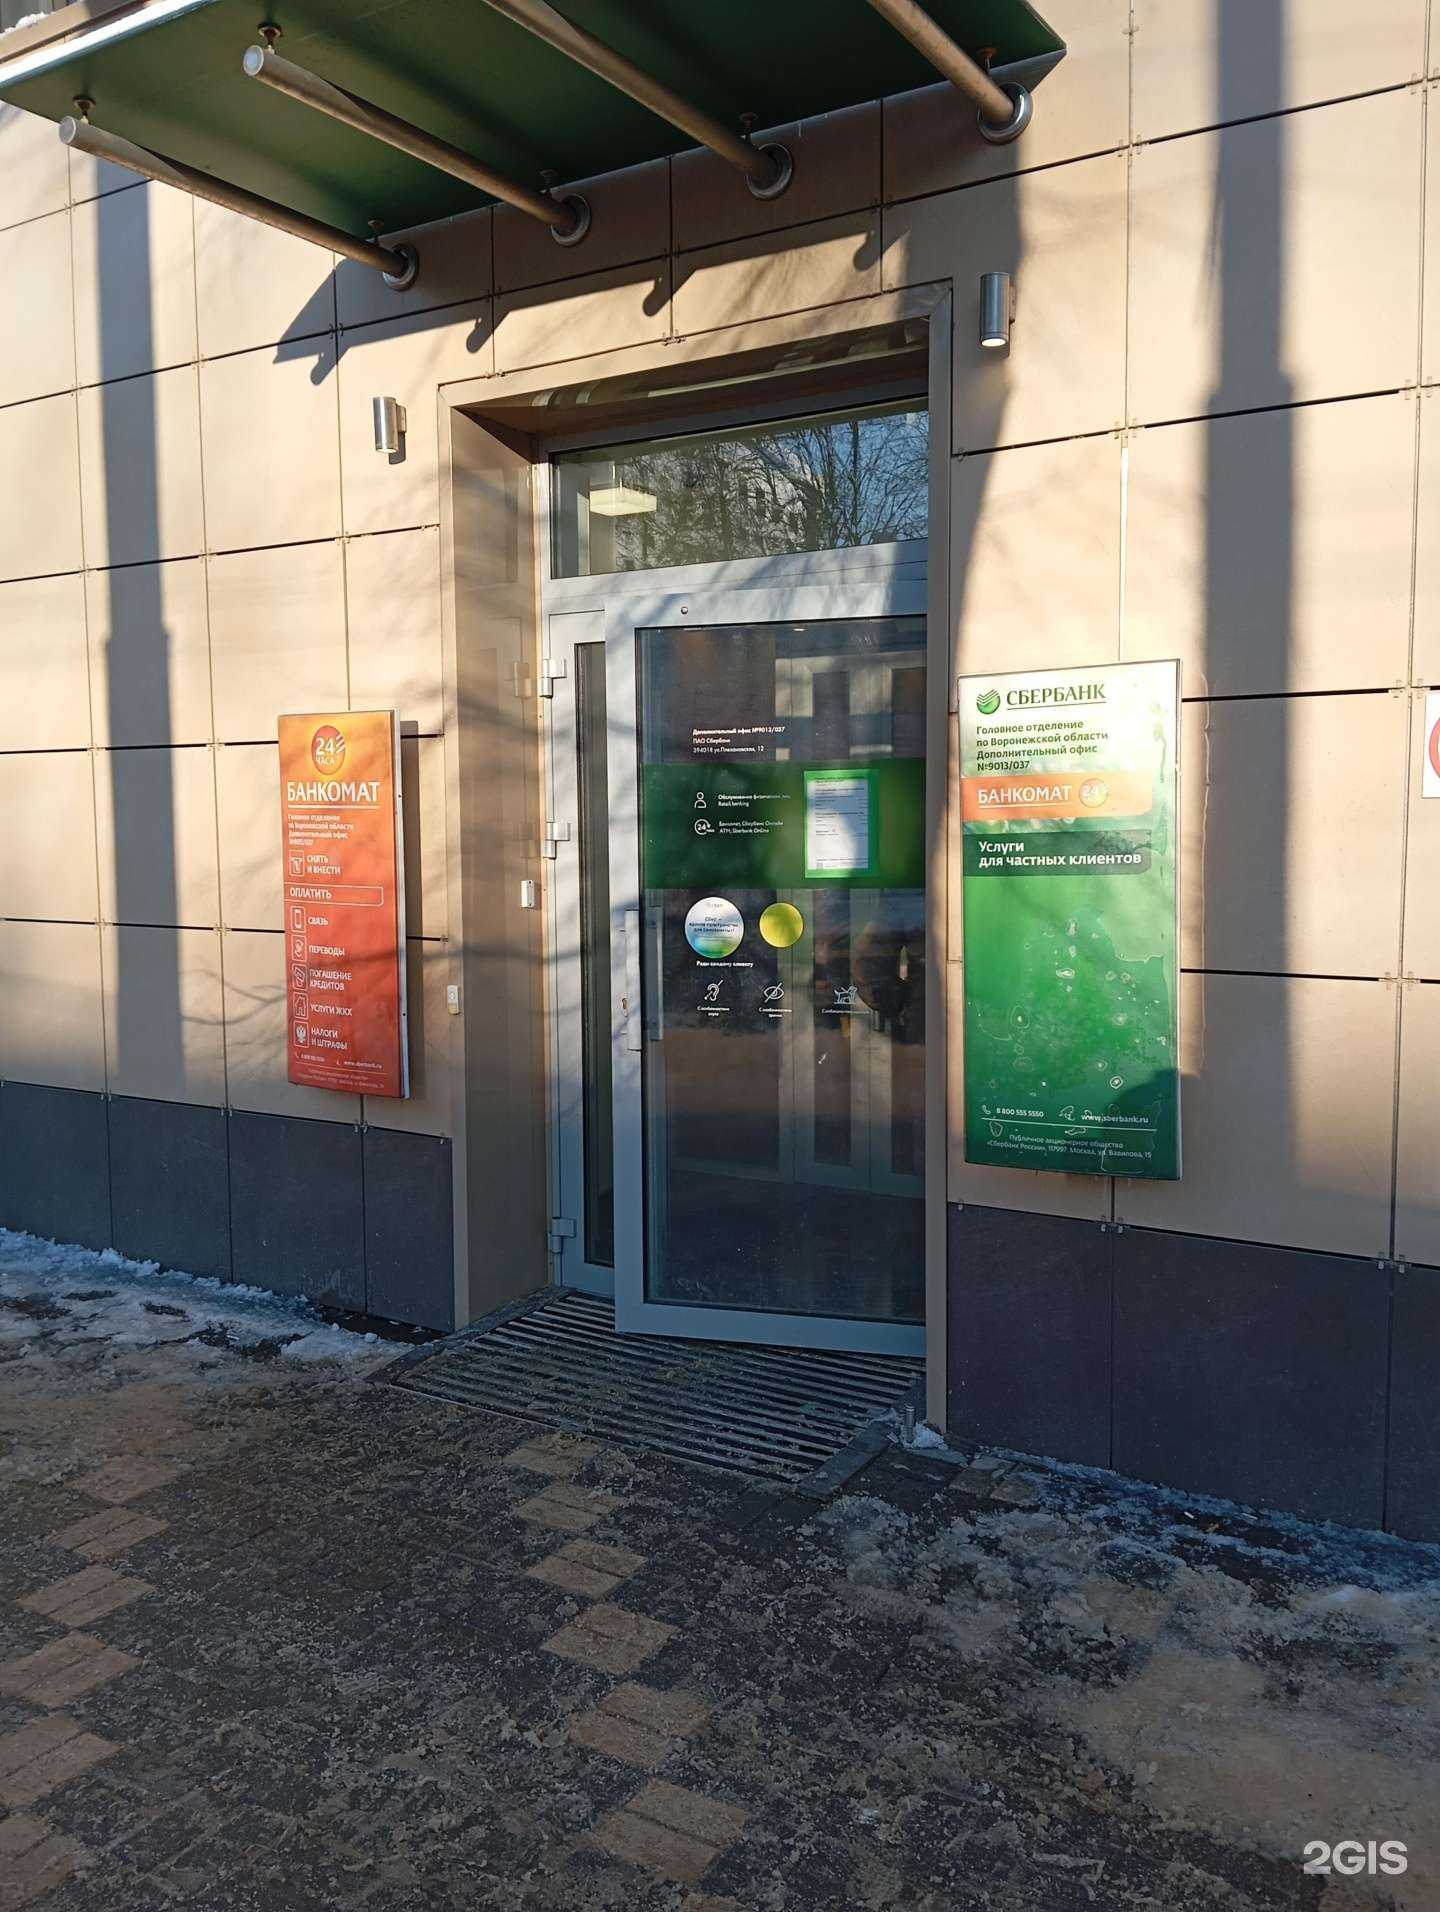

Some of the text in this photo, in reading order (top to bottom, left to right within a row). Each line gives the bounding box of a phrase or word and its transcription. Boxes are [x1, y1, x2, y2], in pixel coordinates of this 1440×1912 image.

[1006, 684, 1106, 706] СБЕРБАНК
[976, 720, 1084, 735] Головное отделение
[706, 737, 731, 745] Сбербанк
[976, 731, 1109, 748] по Воронежской области
[316, 737, 335, 756] 24
[976, 744, 1098, 760] Дополнительный офис
[977, 761, 1030, 771] №9013/037
[287, 781, 380, 802] БАНКОМАТ
[978, 785, 1072, 804] БАНКОМАТ
[1082, 785, 1100, 797] 24
[697, 823, 707, 831] 24
[979, 841, 1025, 855] Услуги
[306, 854, 329, 863] СНЯТЬ
[979, 853, 1142, 868] для частных клиентов
[313, 866, 340, 875] ВНЕСТИ
[290, 887, 332, 899] ОПЛАТИТЬ
[307, 917, 329, 926] СВЯЗЬ
[309, 945, 345, 956] ПЕРЕВОДЫ
[309, 968, 353, 981] ПОГАШЕНИЕ
[309, 980, 345, 991] КРЕДИТОВ
[310, 1003, 353, 1017] УСЛУГИ ЖКХ
[311, 1027, 338, 1038] НАЛОГИ
[317, 1040, 347, 1050] ШТРАФЫ
[1001, 1108, 1015, 1116] 800
[1015, 1109, 1027, 1117] 555
[1027, 1110, 1045, 1118] 5550
[1080, 1113, 1149, 1124] www.sberbank.ru
[1009, 1135, 1044, 1144] Публичное
[1089, 1140, 1124, 1149] общество
